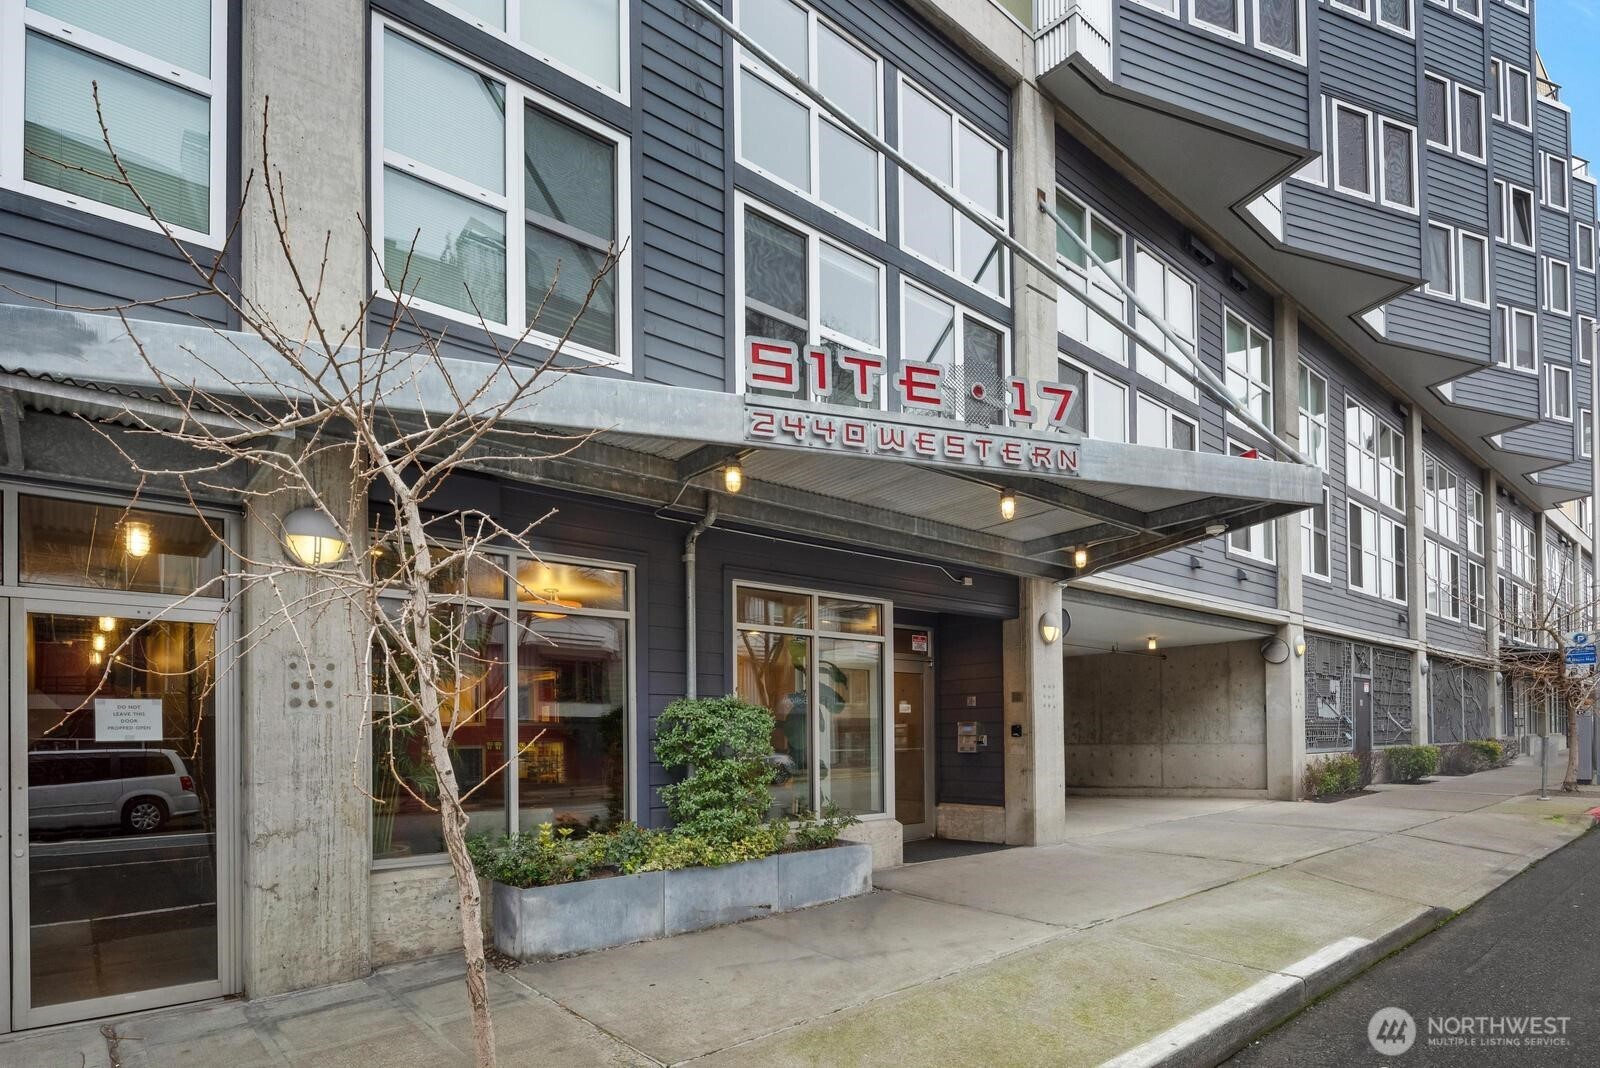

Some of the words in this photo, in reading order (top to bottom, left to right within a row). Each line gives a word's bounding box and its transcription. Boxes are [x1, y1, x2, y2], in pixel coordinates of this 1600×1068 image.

[1007, 376, 1077, 424] 17
[750, 410, 869, 446] 2440
[876, 425, 1080, 471] WESTERN
